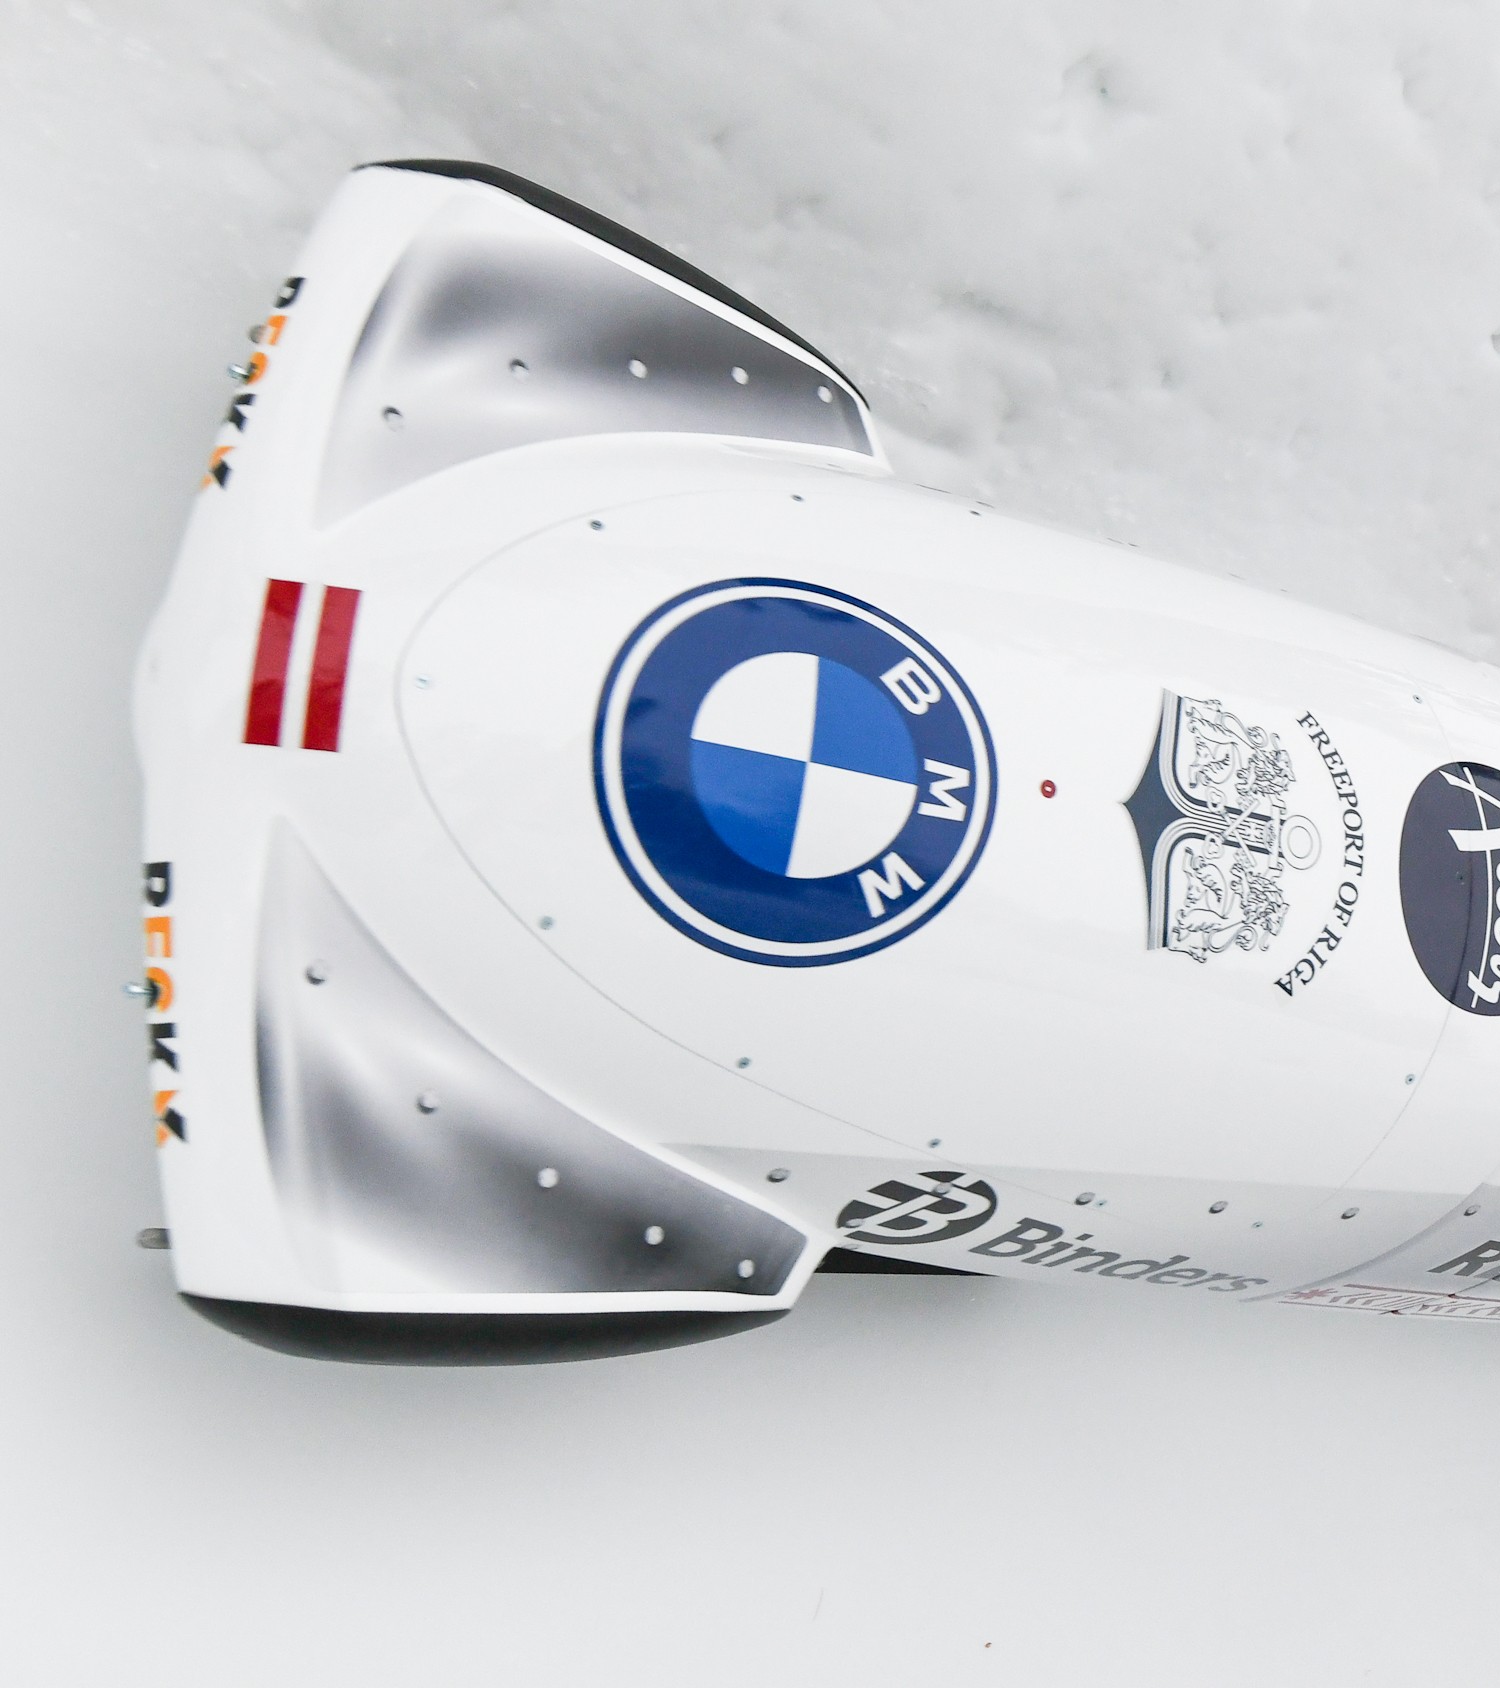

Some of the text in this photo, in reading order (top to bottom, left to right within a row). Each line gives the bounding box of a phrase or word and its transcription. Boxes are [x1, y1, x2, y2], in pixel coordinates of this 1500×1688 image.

[857, 656, 971, 919] BMW
[1274, 711, 1364, 997] FREEPORT OF RIGA
[968, 1217, 1269, 1292] Binders
